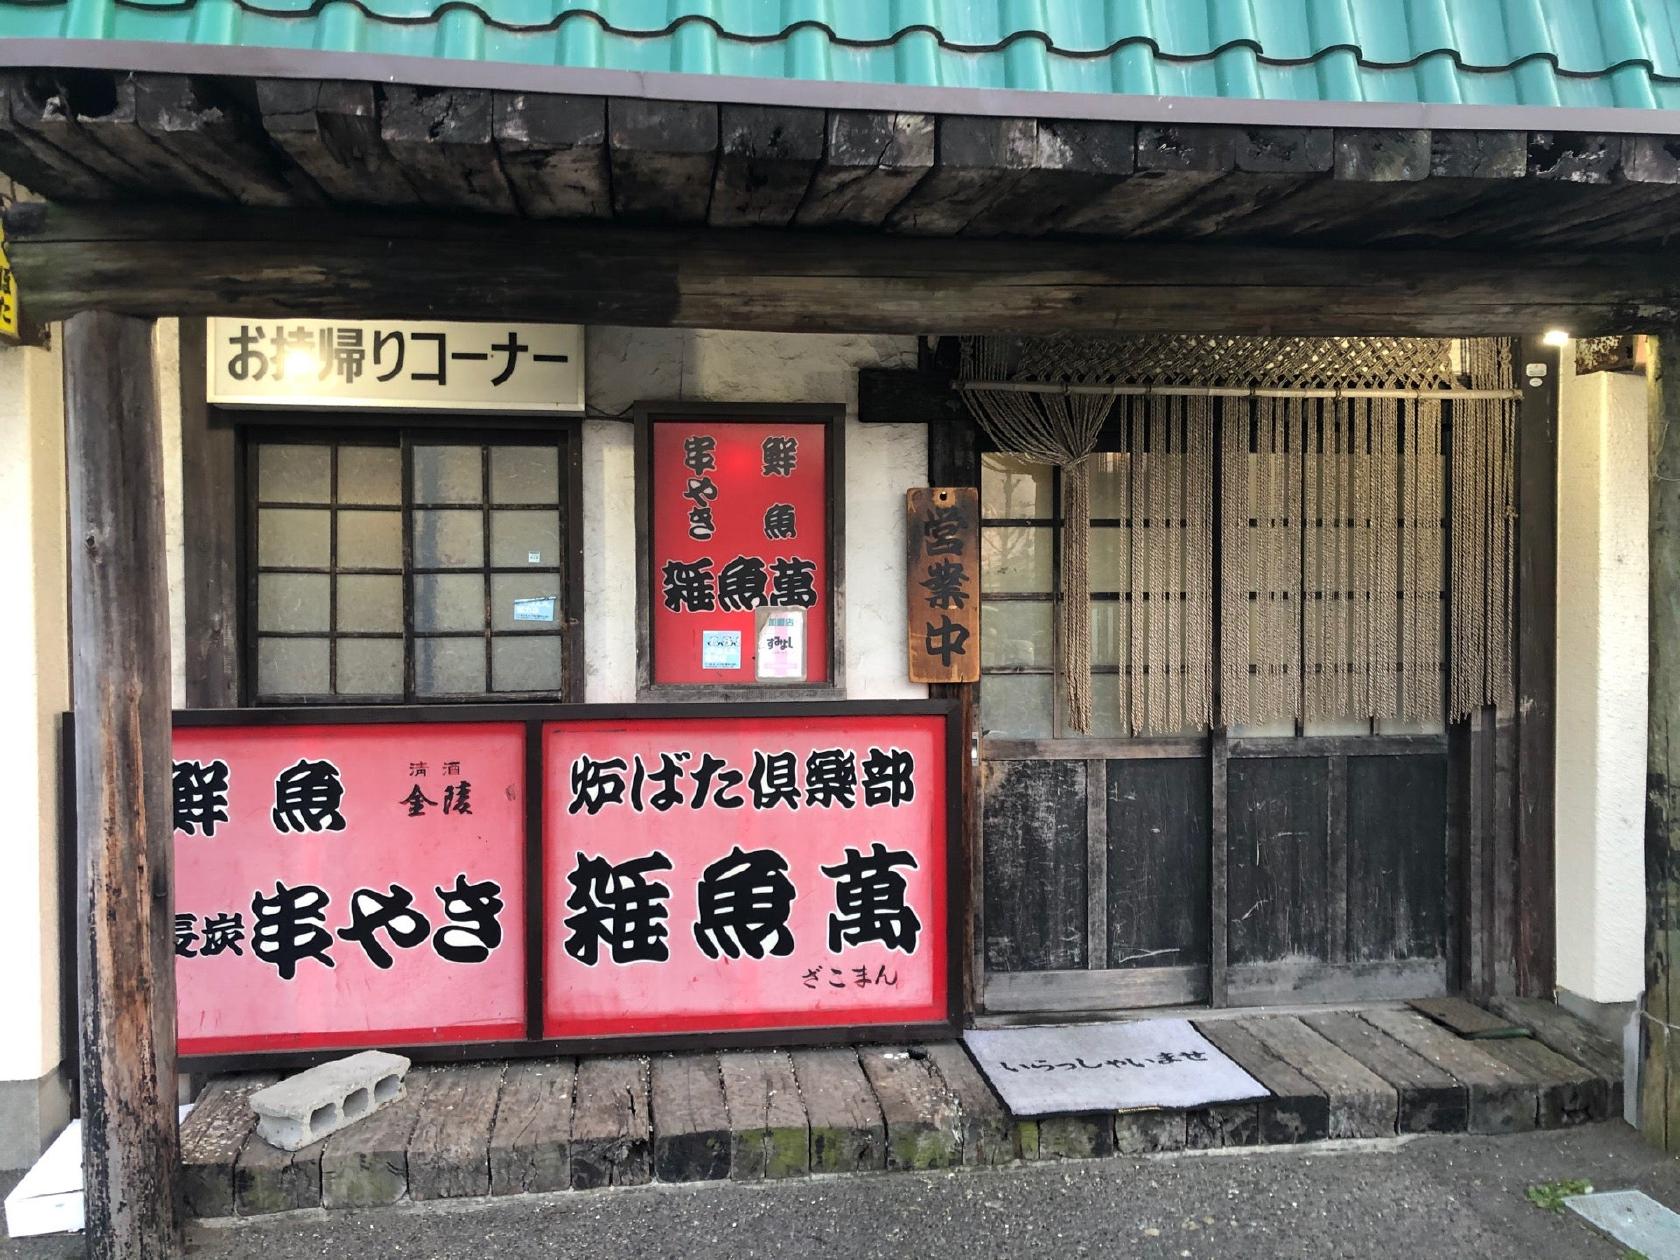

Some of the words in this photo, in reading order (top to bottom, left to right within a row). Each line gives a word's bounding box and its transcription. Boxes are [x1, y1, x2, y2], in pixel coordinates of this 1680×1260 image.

[684, 436, 717, 540] 串やき
[761, 436, 799, 540] 鮮魚
[662, 556, 818, 613] 雑魚萬
[920, 508, 971, 667] 営業中
[251, 874, 504, 981] 串やき
[564, 842, 922, 966] 雑魚萬
[802, 964, 898, 989] ざこまん
[1000, 1050, 1207, 1073] いらっしゃいませ
